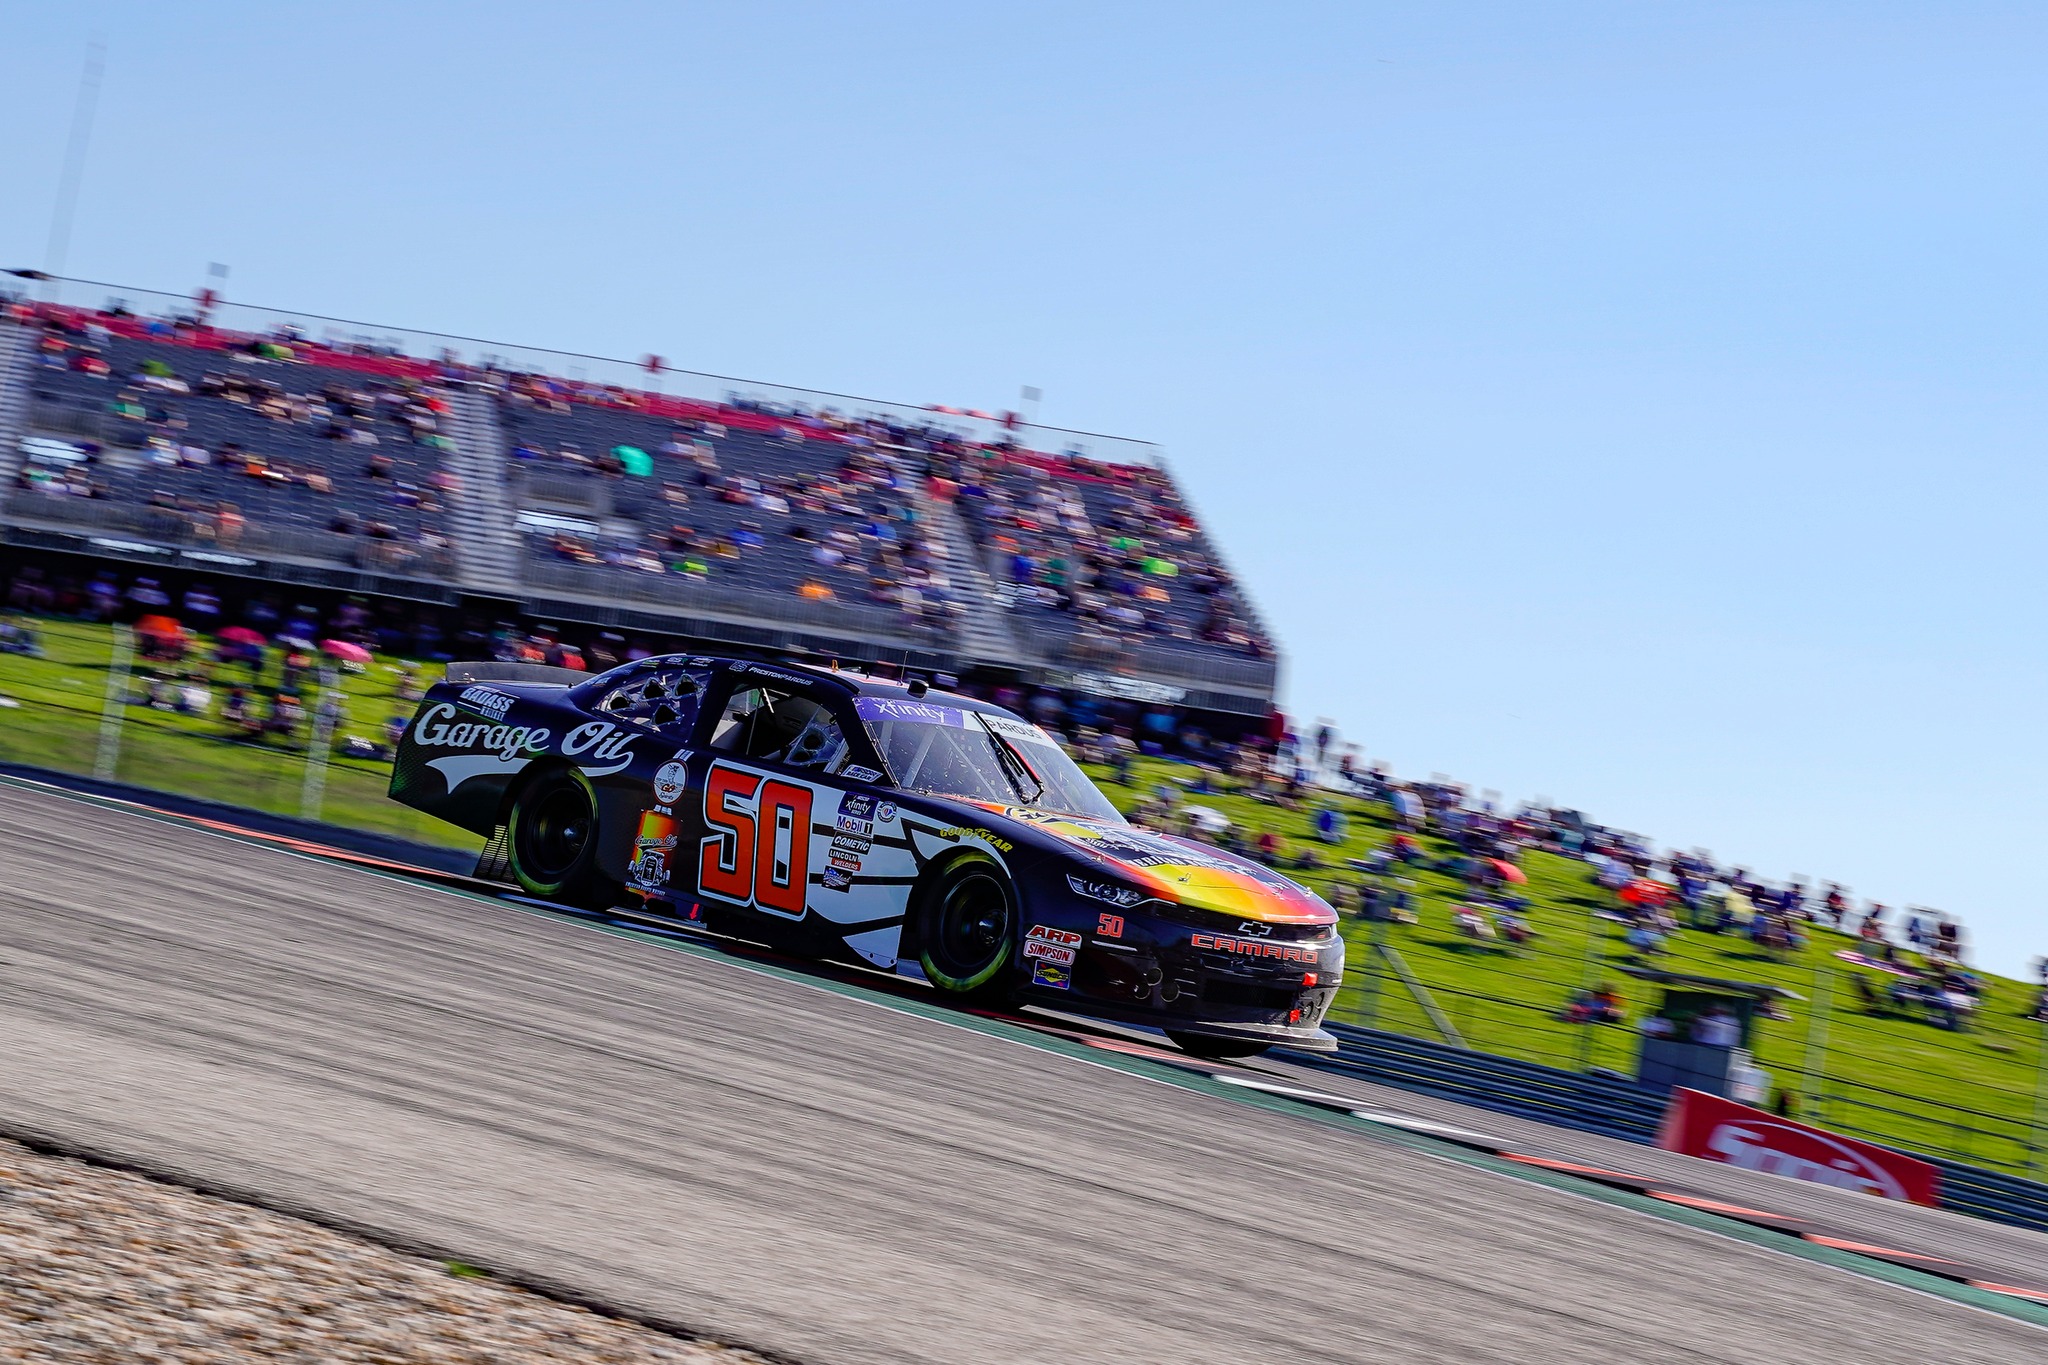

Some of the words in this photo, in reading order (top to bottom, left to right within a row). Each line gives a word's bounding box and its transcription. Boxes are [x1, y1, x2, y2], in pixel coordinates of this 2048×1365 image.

[459, 687, 515, 712] BADASS
[874, 699, 946, 724] xfinity
[988, 718, 1043, 740] PARDUS
[413, 702, 551, 762] Garage
[560, 721, 643, 777] Oil
[845, 799, 871, 815] xfinity
[836, 815, 863, 832] Mobil
[698, 758, 815, 922] 50
[834, 835, 870, 851] COMETIC
[939, 826, 1014, 853] GOODYEAR
[829, 849, 858, 862] LINCOLN
[834, 859, 859, 871] WELDERS
[1028, 926, 1081, 944] ARP
[1097, 912, 1125, 938] 50
[1027, 943, 1071, 961] SIMPSON
[1191, 933, 1319, 965] CAMARO
[1036, 968, 1070, 981] SUNOCO
